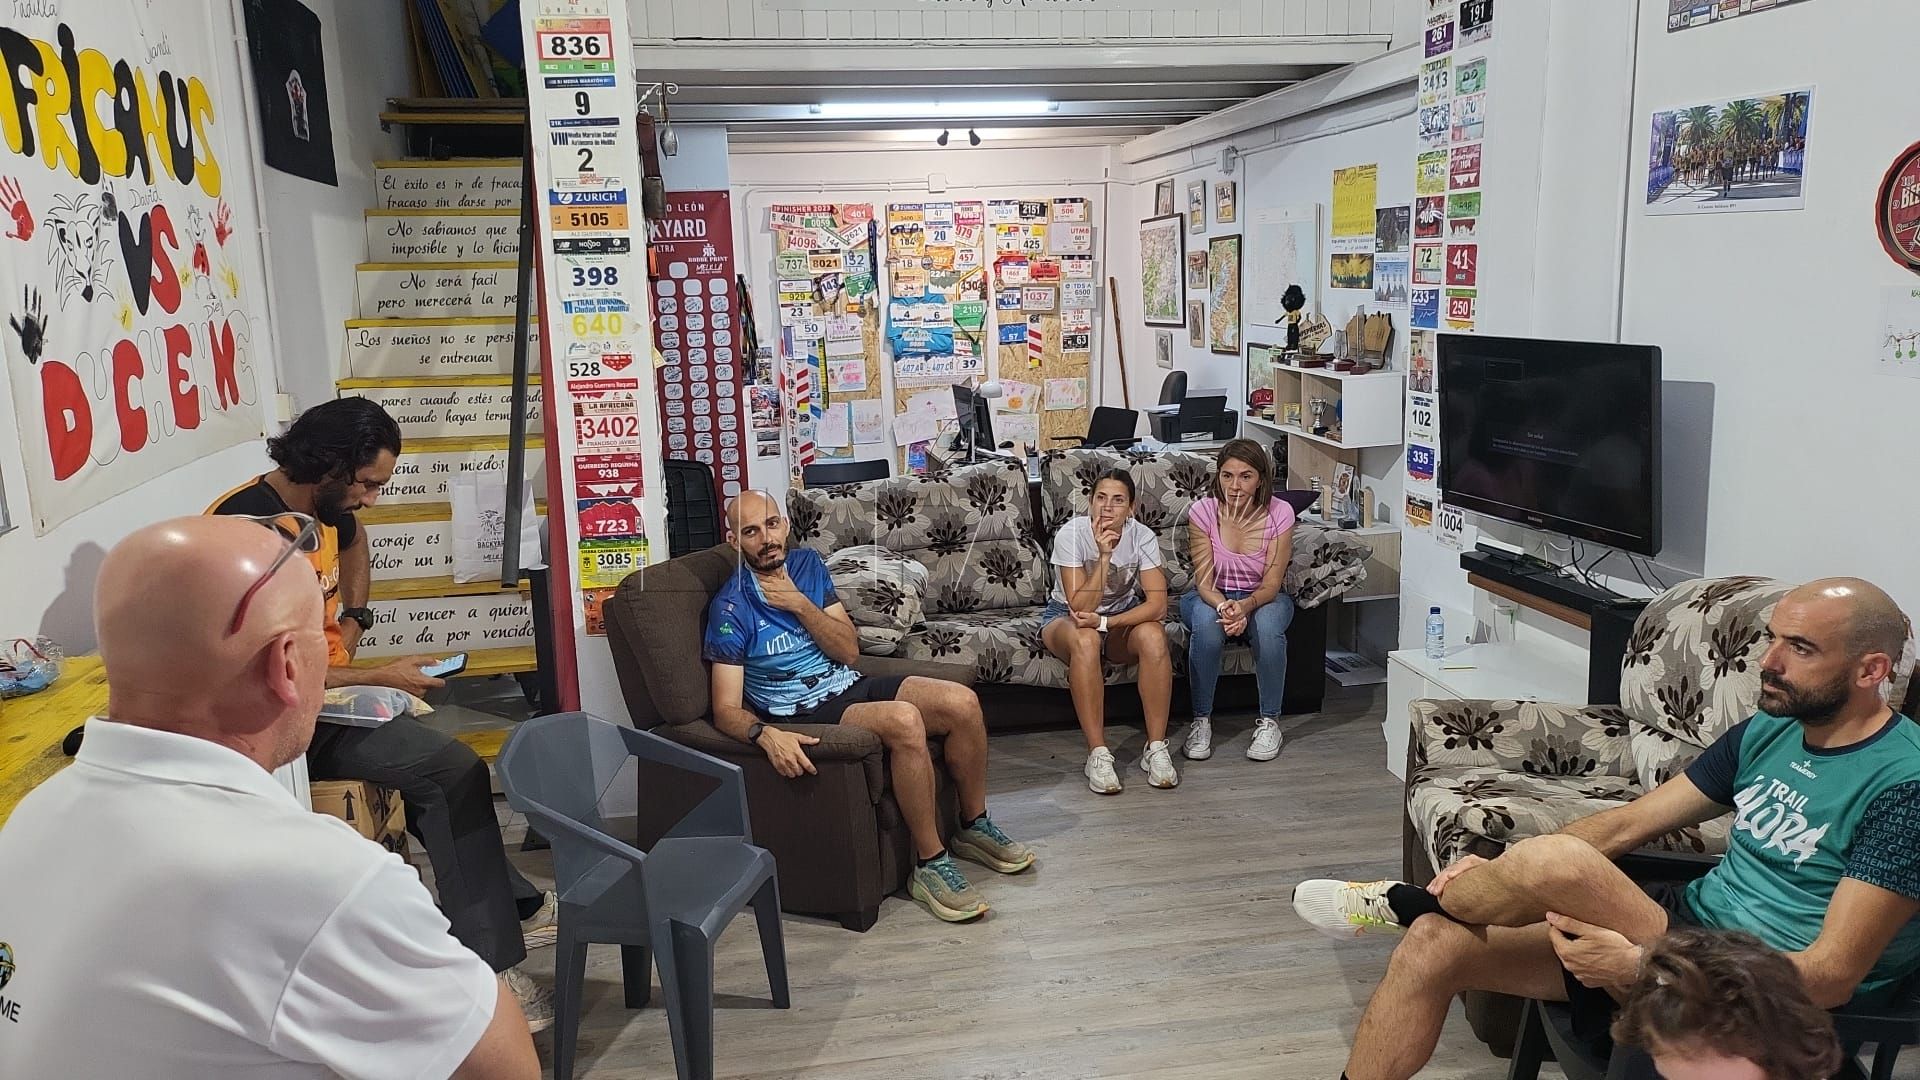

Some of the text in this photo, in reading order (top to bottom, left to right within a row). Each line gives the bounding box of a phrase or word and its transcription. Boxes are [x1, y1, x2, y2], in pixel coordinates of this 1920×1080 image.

[1470, 3, 1485, 22] 191
[1431, 25, 1447, 43] 261
[551, 36, 601, 56] 836
[575, 91, 590, 115] 9
[551, 132, 568, 145] VIII
[577, 148, 594, 172] 2
[383, 175, 396, 190] El
[404, 177, 428, 190] éxito
[436, 180, 446, 190] es
[455, 179, 463, 189] ir
[472, 176, 483, 189] de
[387, 194, 512, 211] fracaso sin darse por
[576, 192, 617, 202] ZURICH
[678, 200, 705, 212] LEÓN
[813, 204, 831, 212] 2023
[571, 213, 609, 226] 5105
[781, 214, 795, 223] 440
[851, 211, 866, 219] 401
[387, 220, 412, 236] No
[486, 226, 507, 240] que
[652, 219, 706, 238] KYARD
[934, 230, 946, 241] 20
[391, 240, 447, 258] imposible
[457, 245, 463, 258] y
[473, 241, 484, 254] lo
[1023, 240, 1040, 249] 425
[118, 204, 181, 316] VS
[1421, 248, 1432, 262] 72
[1452, 248, 1469, 270] 41
[786, 260, 802, 270] 737
[400, 272, 426, 290] No
[435, 277, 462, 288] será
[572, 267, 618, 286] 398
[821, 279, 839, 292] 143
[377, 292, 494, 313] pero merecerá la
[1412, 290, 1429, 303] 233
[791, 308, 803, 317] 23
[963, 306, 982, 314] 2103
[1452, 300, 1468, 315] 250
[572, 313, 623, 337] 640
[805, 324, 818, 333] 50
[355, 330, 380, 347] Los
[391, 333, 431, 346] sueños
[440, 336, 455, 344] no
[464, 336, 476, 344] se
[1076, 336, 1087, 344] 63
[419, 352, 493, 364] se entrenan
[962, 360, 977, 369] 39
[570, 362, 600, 377] 528
[381, 397, 411, 408] pares
[420, 391, 460, 406] cuando
[467, 393, 493, 404] estés
[397, 409, 438, 424] cuando
[445, 409, 477, 426] hayas
[1412, 409, 1431, 427] 102
[583, 416, 638, 439] 3402
[430, 461, 449, 474] sin
[460, 454, 505, 472] miedos
[1413, 450, 1429, 465] 335
[599, 469, 619, 478] 938
[378, 482, 426, 497] ntrena
[596, 519, 628, 533] 723
[1439, 511, 1463, 534] 1004
[372, 533, 440, 551] coraje es
[414, 556, 433, 566] un
[597, 553, 631, 565] 3085
[408, 603, 529, 621] vencer a quien
[389, 634, 404, 646] se
[415, 626, 434, 643] da
[446, 630, 471, 646] por
[483, 620, 535, 639] vencido
[1768, 778, 1809, 813] TRAIL
